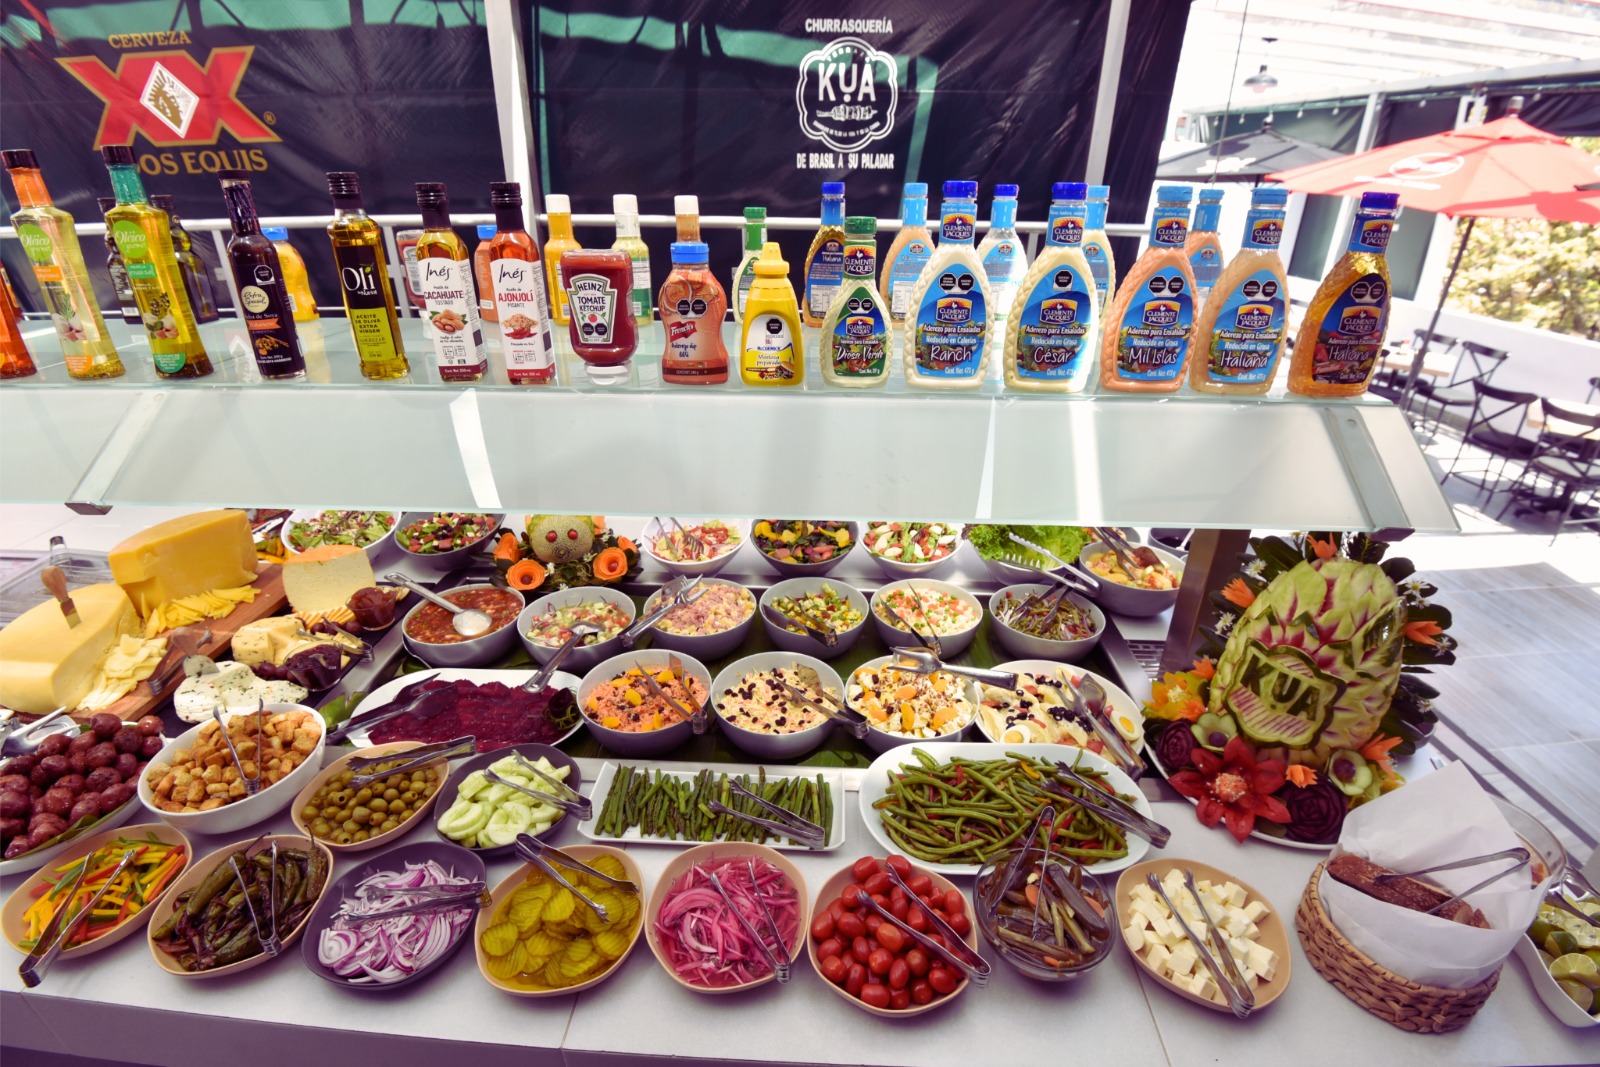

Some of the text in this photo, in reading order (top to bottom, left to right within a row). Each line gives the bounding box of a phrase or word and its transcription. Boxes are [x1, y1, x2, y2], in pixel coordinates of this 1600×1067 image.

[805, 16, 894, 33] CHURRASQUERÍA
[108, 31, 192, 49] CERVEZA
[137, 149, 268, 175] OS EQUIS
[797, 153, 894, 169] DE BRASIL A SU PALADAR
[845, 257, 874, 265] CLEMENTE
[847, 264, 873, 272] JACQUES
[426, 262, 450, 281] Inés
[498, 264, 524, 283] Inés
[577, 282, 602, 292] HEINZ
[424, 290, 464, 300] CACAHUATE
[498, 289, 534, 302] AJONJOLÍ
[923, 324, 943, 332] Aderezo
[1026, 325, 1047, 333] Aderezo
[1128, 327, 1149, 335] Aderezo
[1220, 330, 1242, 338] Aderezo
[957, 336, 977, 344] Calorías
[1031, 337, 1055, 345] Reducido
[835, 345, 884, 362] Diosa Verde
[931, 345, 971, 361] Ranch
[1034, 346, 1072, 363] César
[1128, 348, 1177, 364] Mil Islas
[1220, 351, 1268, 367] Italiana
[1329, 346, 1370, 361] Italiana
